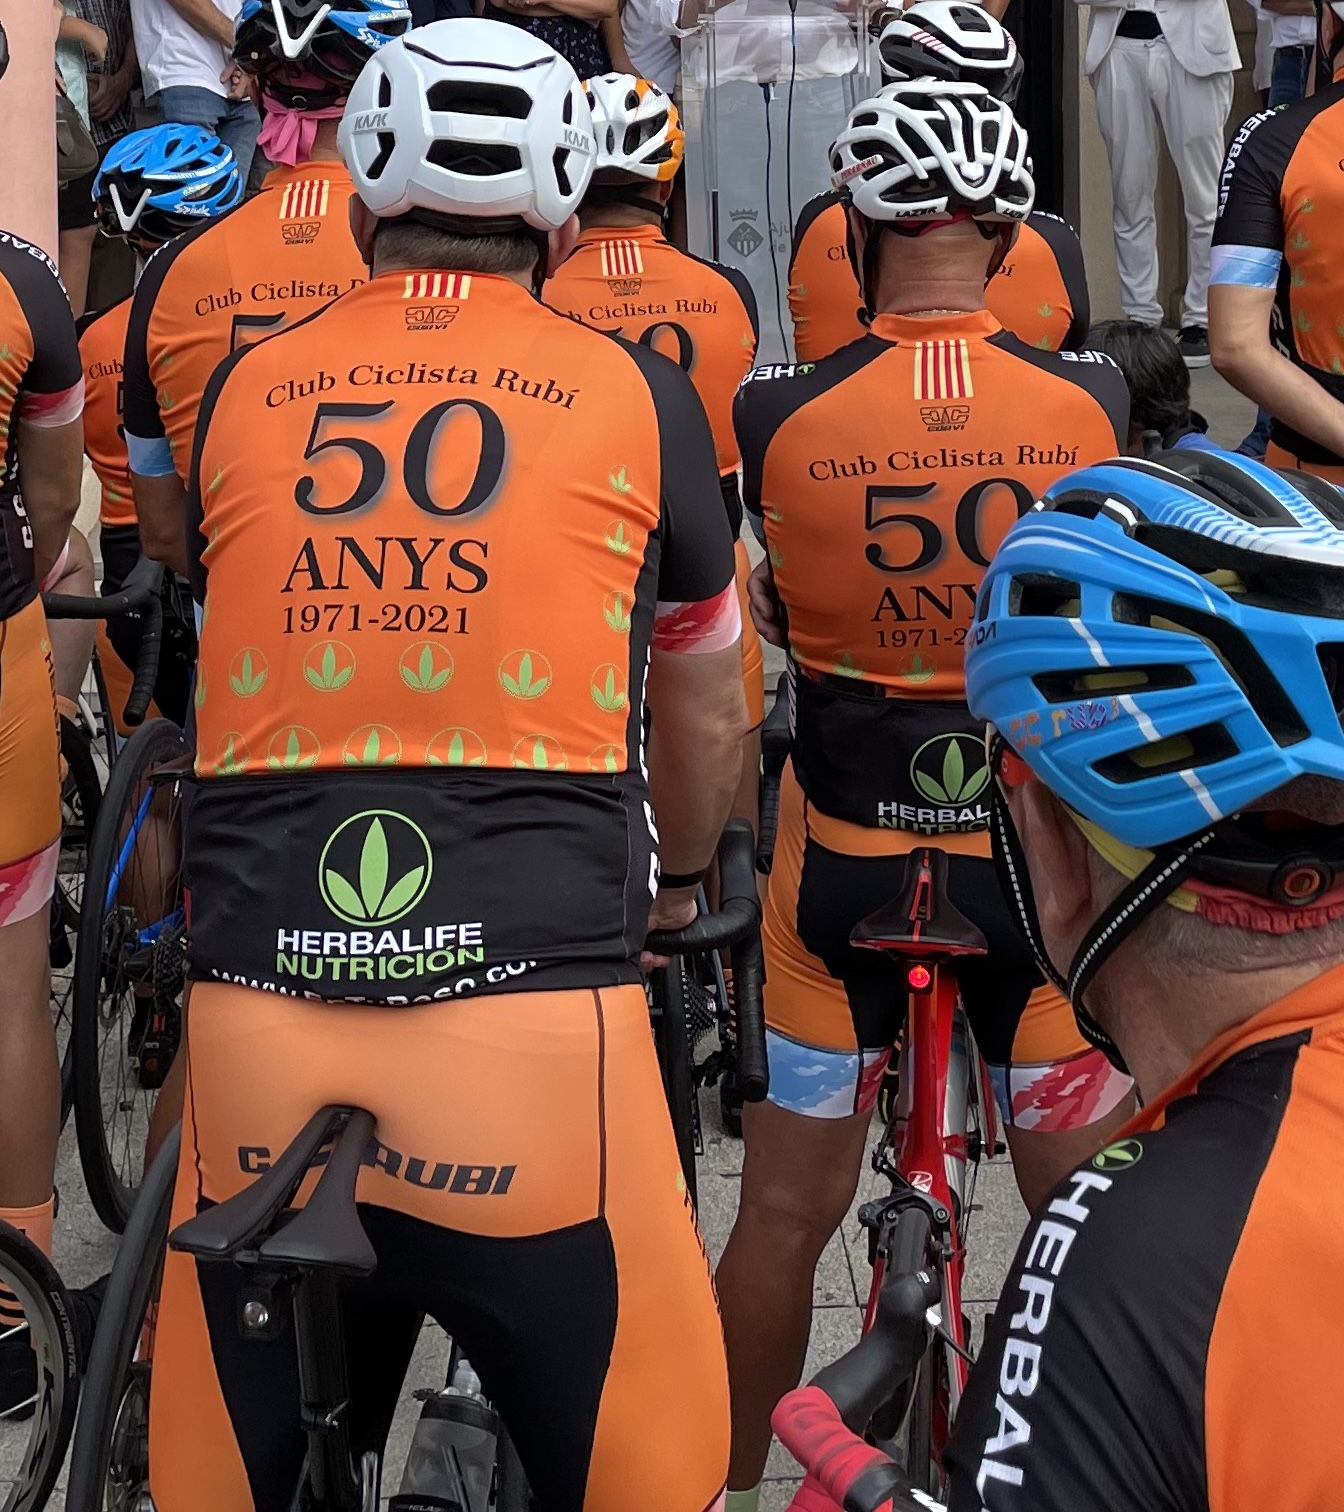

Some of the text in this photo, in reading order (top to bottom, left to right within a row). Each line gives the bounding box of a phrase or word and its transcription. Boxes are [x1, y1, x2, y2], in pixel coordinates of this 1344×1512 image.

[195, 278, 340, 318] Club Ciclista
[588, 299, 719, 322] Ciclista Rubí
[264, 362, 581, 410] Club Ciclista Rubí
[293, 397, 507, 518] 50
[808, 444, 1080, 482] Club Ciclista Rubí
[280, 536, 490, 595] ANYS
[281, 603, 470, 636] 1971-2021
[877, 801, 991, 824] HERBAL
[277, 921, 484, 956] HERBALIFE
[275, 944, 485, 982] NUTRICIÓN
